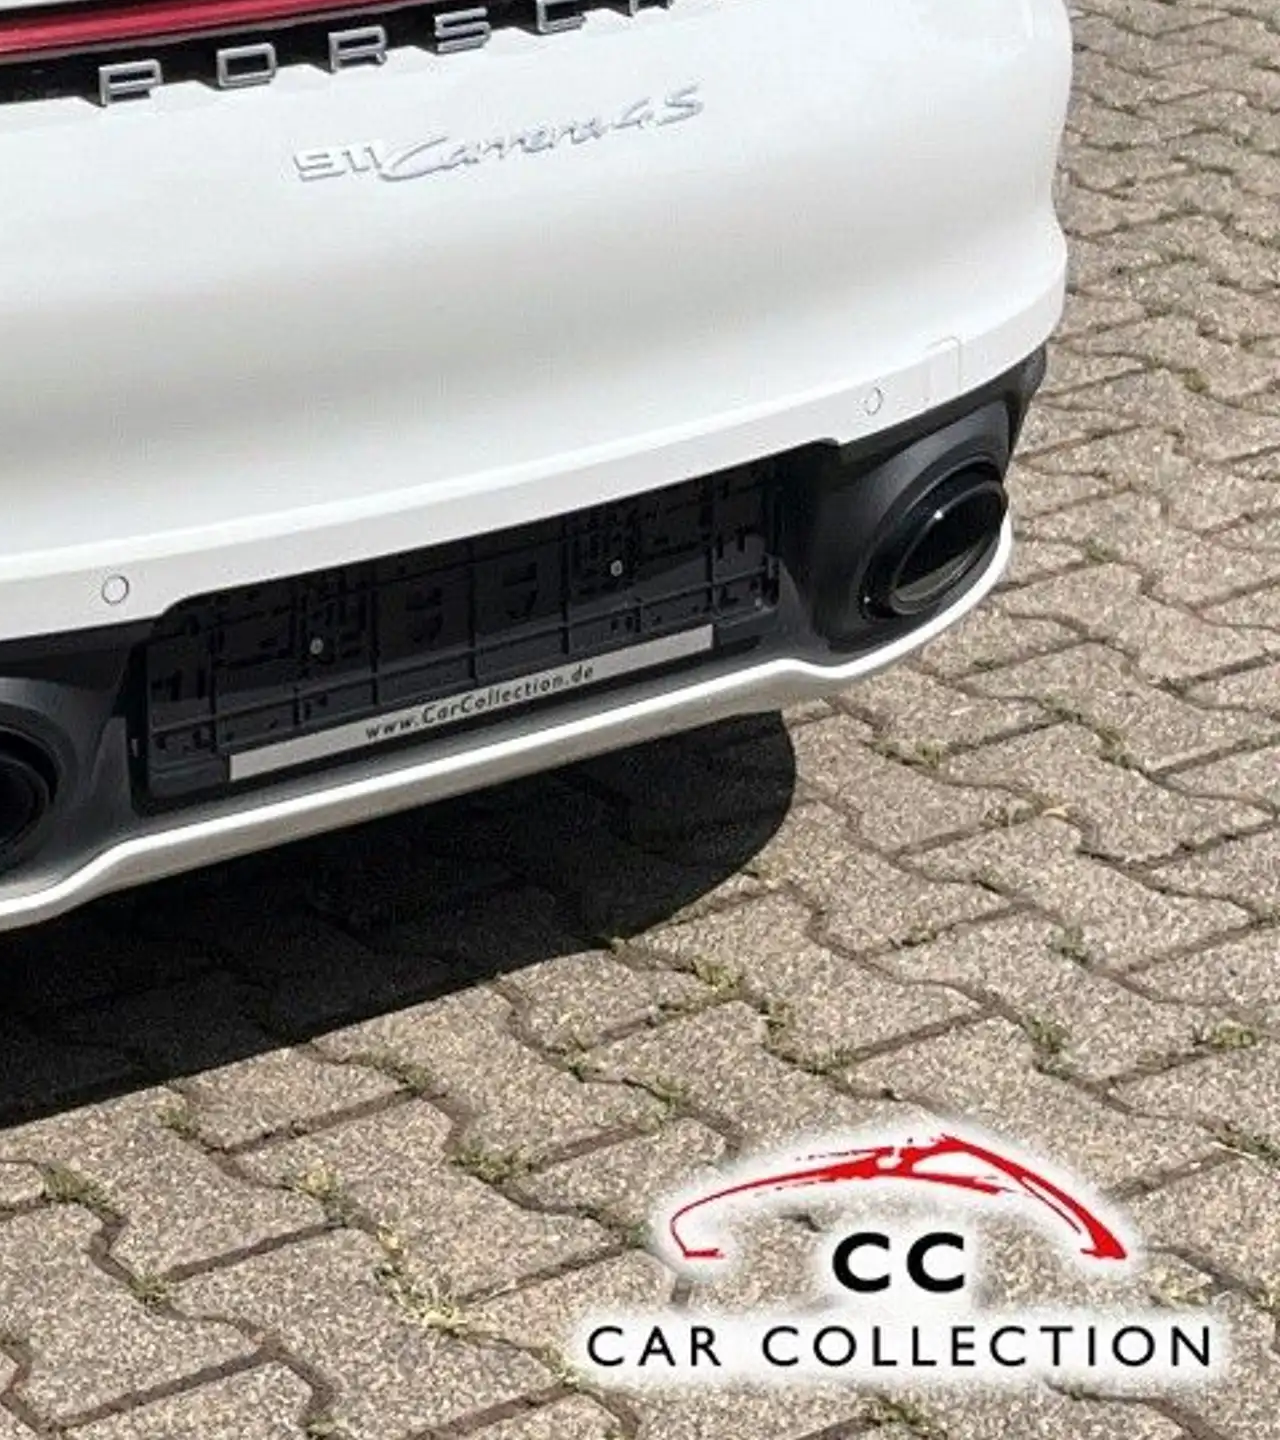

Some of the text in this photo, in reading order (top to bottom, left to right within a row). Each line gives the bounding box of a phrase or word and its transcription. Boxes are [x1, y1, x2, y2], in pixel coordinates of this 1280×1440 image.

[292, 144, 384, 182] 911
[378, 116, 612, 183] Carrera
[365, 664, 596, 741] www.CarCollection.de
